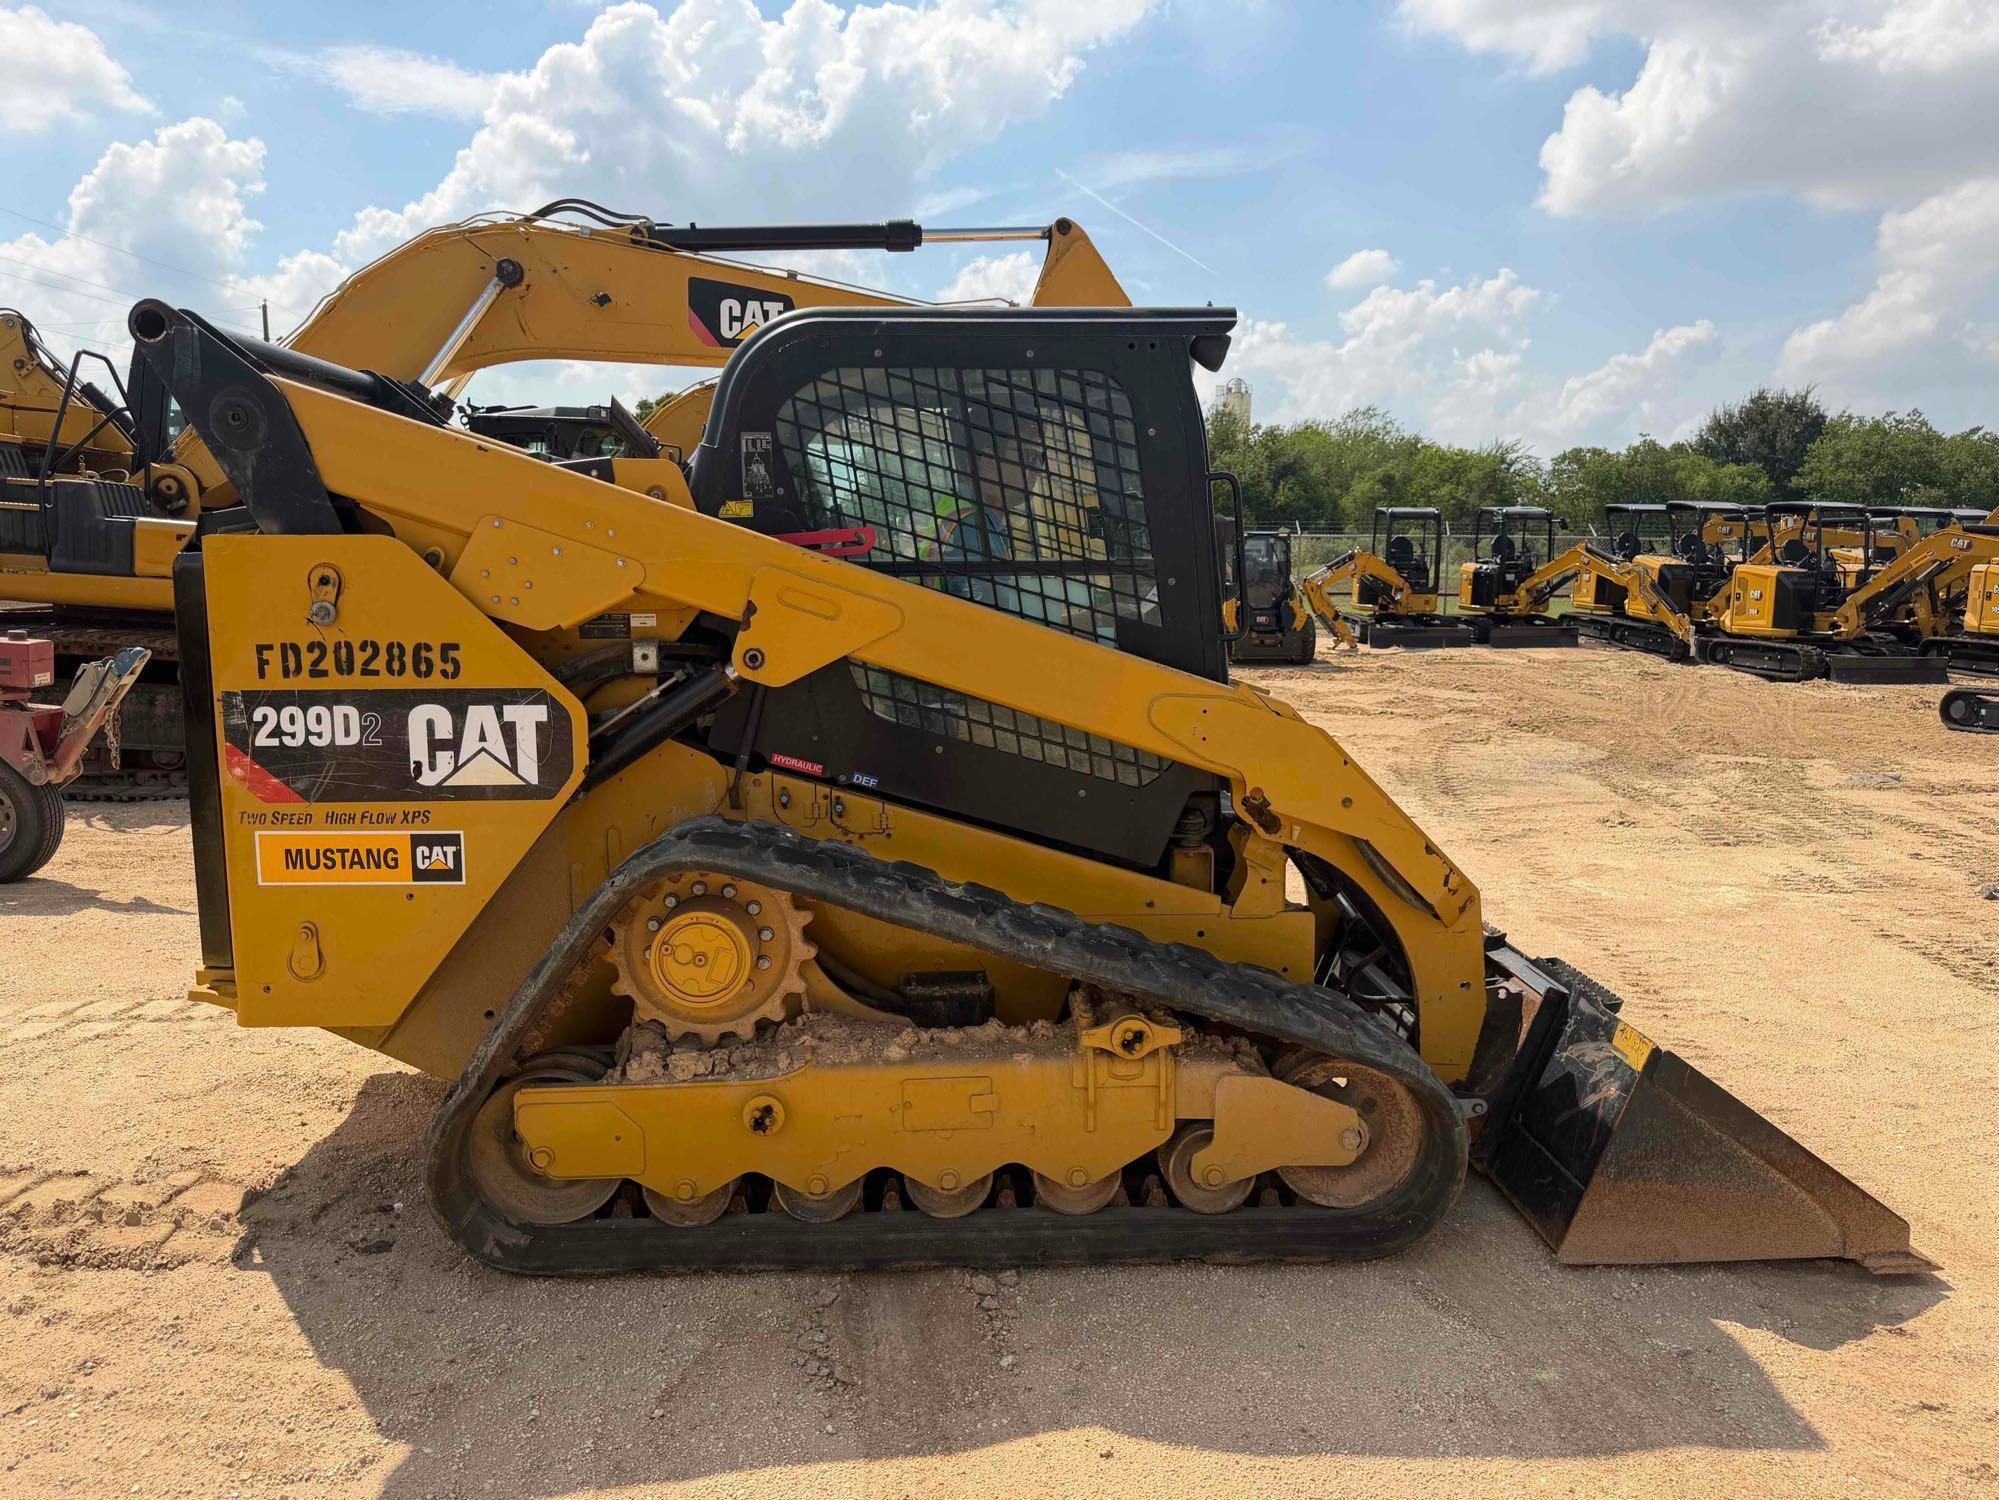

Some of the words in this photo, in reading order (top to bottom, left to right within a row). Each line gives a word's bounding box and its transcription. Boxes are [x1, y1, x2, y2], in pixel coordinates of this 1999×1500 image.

[720, 298, 784, 340] CAT
[1717, 526, 1730, 534] CAT
[1950, 537, 1970, 549] CAT
[1750, 590, 1761, 600] CAT
[255, 640, 461, 679] FD202865
[408, 703, 548, 787] CAT
[774, 755, 822, 773] HYDRAULIC
[853, 773, 878, 787] DEF
[400, 810, 431, 825] XPS
[284, 848, 399, 870] MUSTANG
[416, 845, 458, 871] CAT
